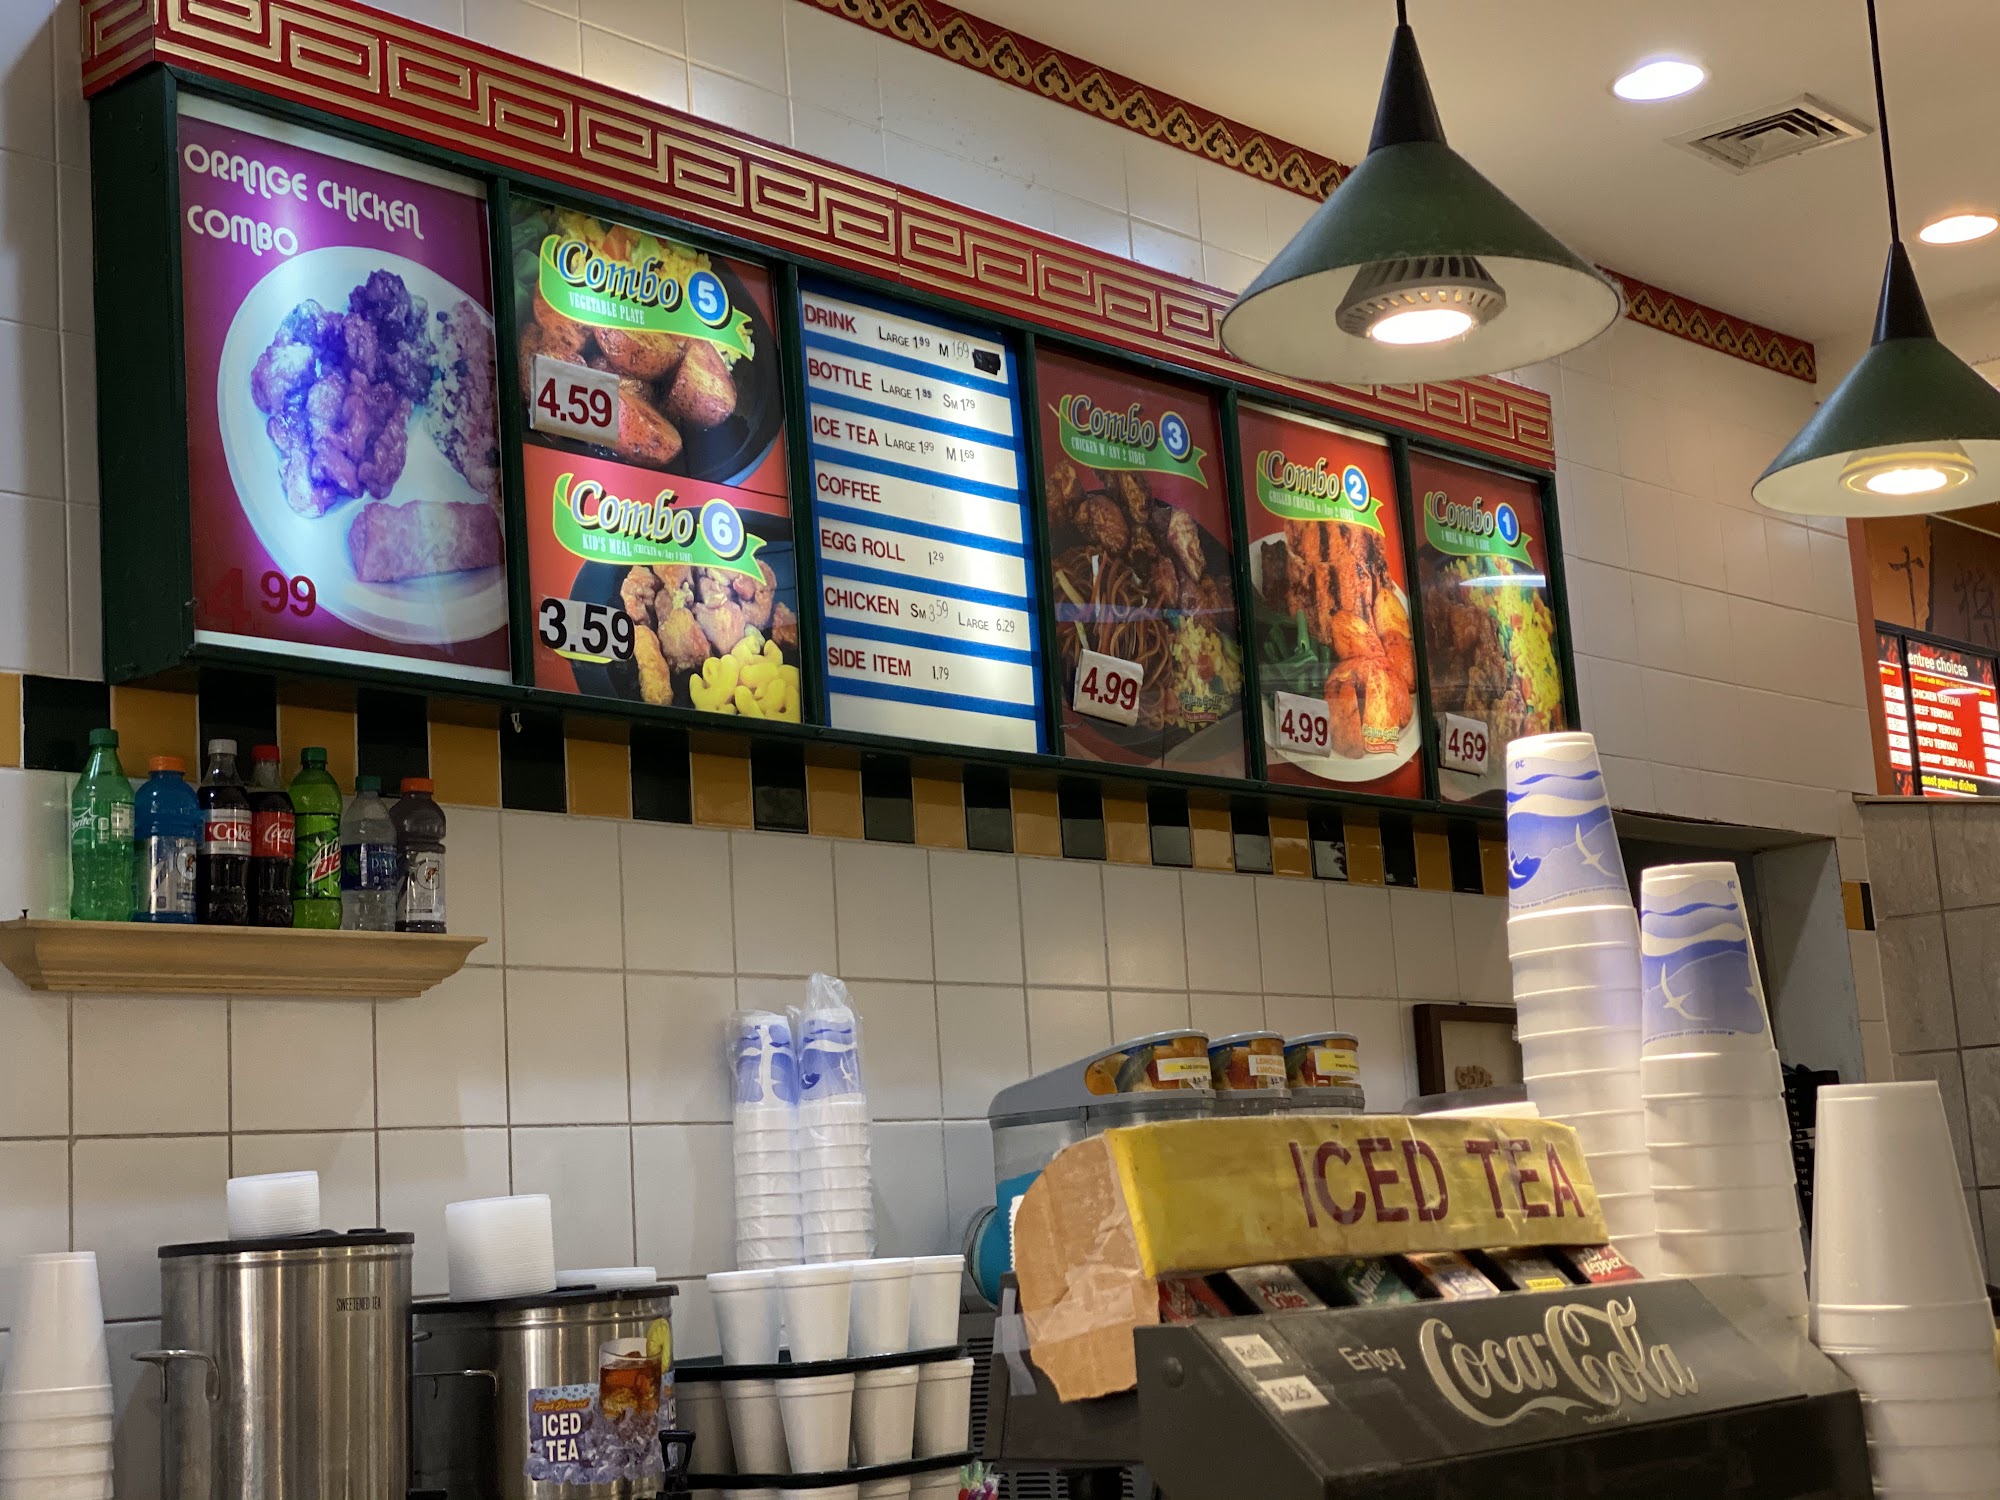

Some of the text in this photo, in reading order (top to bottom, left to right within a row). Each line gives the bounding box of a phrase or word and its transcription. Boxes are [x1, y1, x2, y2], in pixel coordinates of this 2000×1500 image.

[183, 144, 425, 240] ORANGE CHICKEN
[187, 205, 298, 257] COMBO
[556, 240, 715, 313] Combo 5
[569, 291, 645, 325] VEGETABLE PLATE
[804, 303, 857, 333] DRINK
[939, 343, 949, 358] M
[808, 357, 873, 391] BOTTLE
[537, 378, 612, 428] 4.59
[1071, 394, 1183, 450] Combo 3
[813, 415, 841, 438] ICE
[845, 423, 879, 447] TEA
[946, 447, 957, 461] M
[1071, 436, 1098, 454] CHICKEN
[1128, 449, 1146, 466] SIDES
[817, 472, 882, 503] COFFEE
[1266, 450, 1363, 501] Combo 2
[570, 480, 733, 545] Combo 6
[1432, 491, 1512, 536] Combo 1
[582, 533, 606, 553] KID'S
[608, 538, 633, 557] MEAL
[821, 528, 944, 566] EGG ROLL 1.29
[539, 598, 635, 660] 3.59
[824, 587, 900, 617] CHICKEN
[996, 618, 1016, 633] 6.29
[828, 647, 950, 681] SIDE ITEM 1.79
[1907, 652, 1969, 677] entree choices
[1081, 666, 1138, 711] 4.99
[1912, 688, 1938, 702] CHICKEN
[1281, 709, 1328, 747] 4.99
[1448, 728, 1487, 762] 4.69
[1941, 755, 1968, 769] TEMPURA
[1937, 777, 1959, 790] popular
[1958, 780, 1978, 793] dishes
[213, 822, 252, 842] Coke
[1288, 1137, 1586, 1228] ICED TEA
[1338, 1345, 1407, 1374] Enjoy
[1418, 1295, 1698, 1427] Coca-Cola
[542, 1413, 582, 1437] ICED
[546, 1438, 580, 1463] TEA
